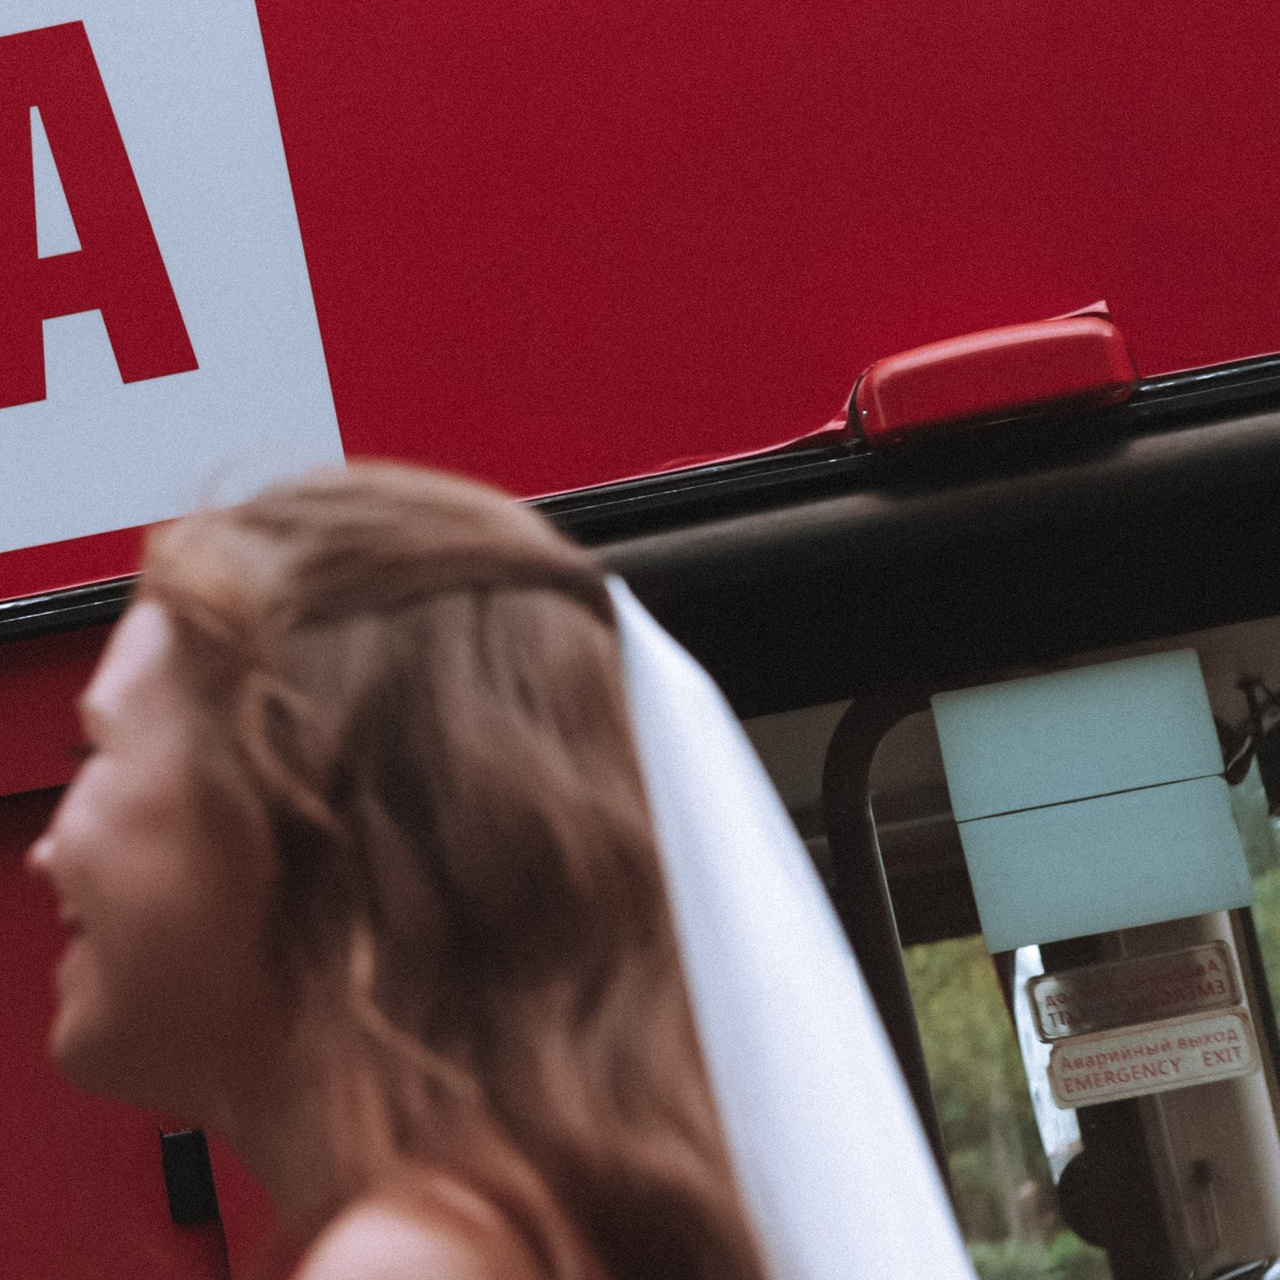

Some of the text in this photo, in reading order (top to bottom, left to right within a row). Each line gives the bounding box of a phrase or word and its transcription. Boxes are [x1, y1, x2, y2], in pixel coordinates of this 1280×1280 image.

[1060, 1029, 1238, 1070] Аварийный выход
[1063, 1045, 1242, 1094] EMERGENCY EXIT
